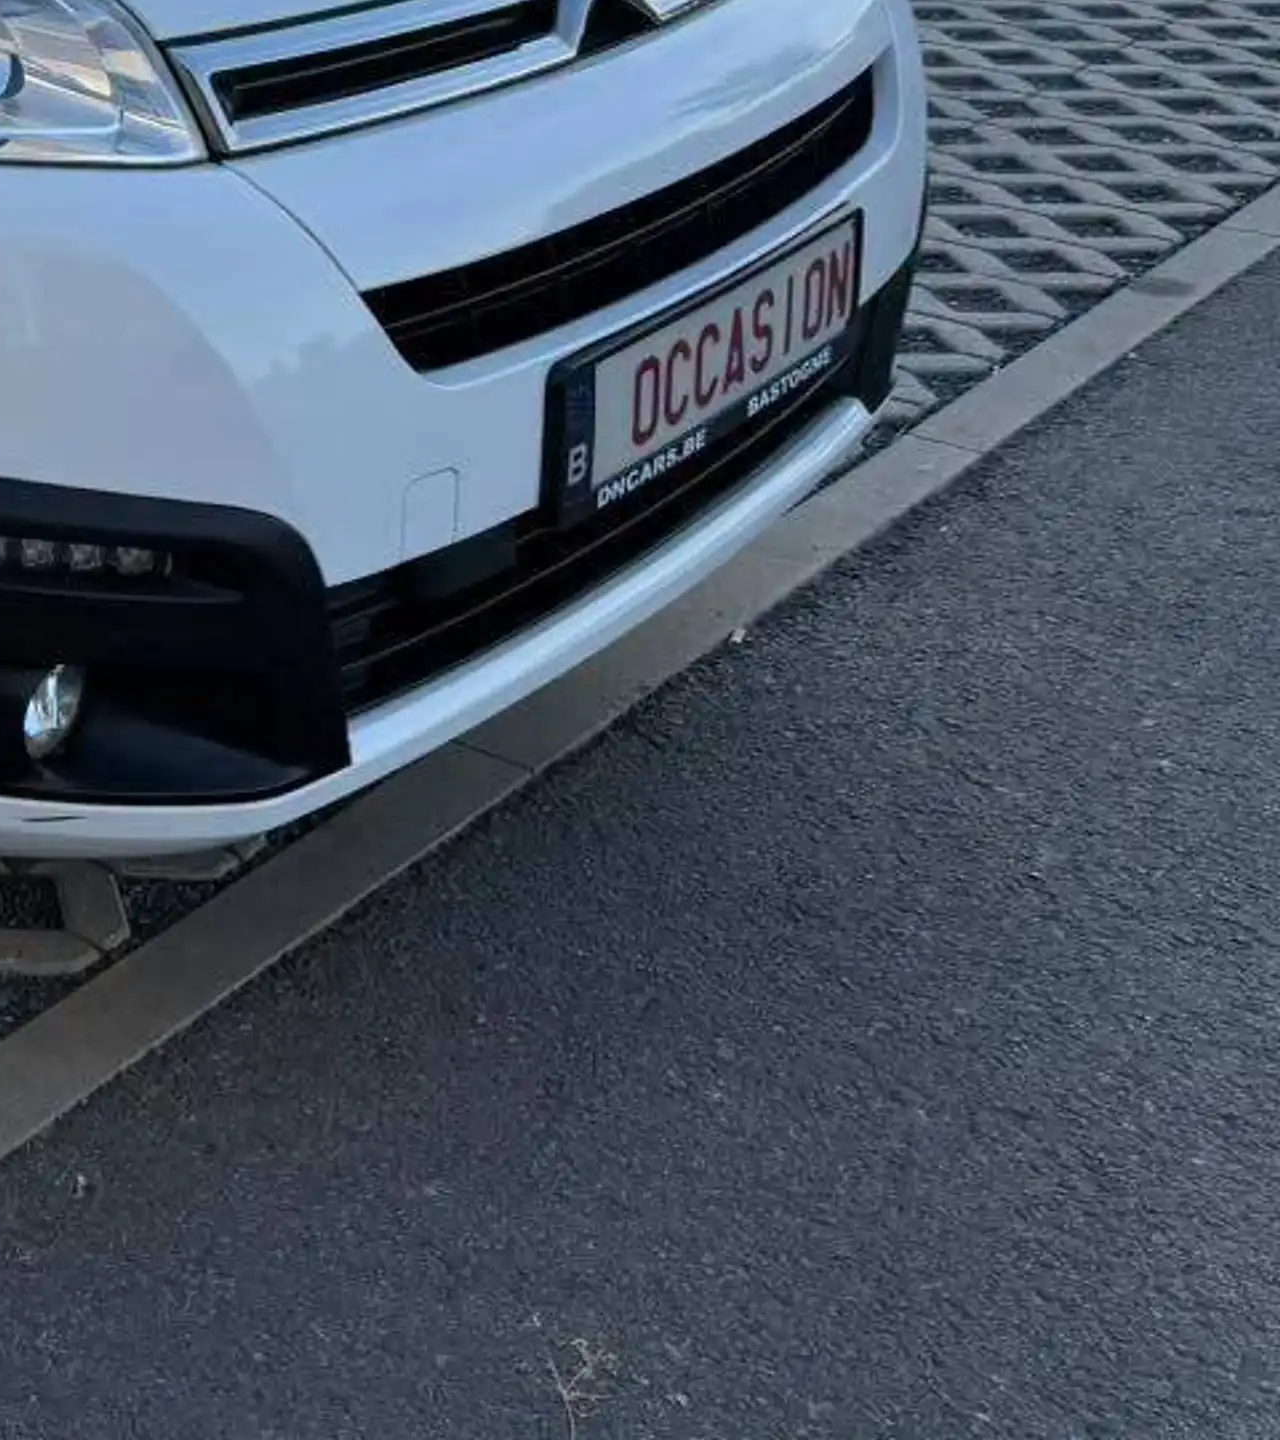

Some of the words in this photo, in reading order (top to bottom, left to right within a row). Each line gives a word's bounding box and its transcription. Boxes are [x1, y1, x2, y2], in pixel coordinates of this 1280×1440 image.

[632, 240, 850, 446] OCCASION
[567, 443, 589, 486] B
[596, 428, 708, 509] DNCARS.BE
[746, 345, 833, 418] BASTOGNE
